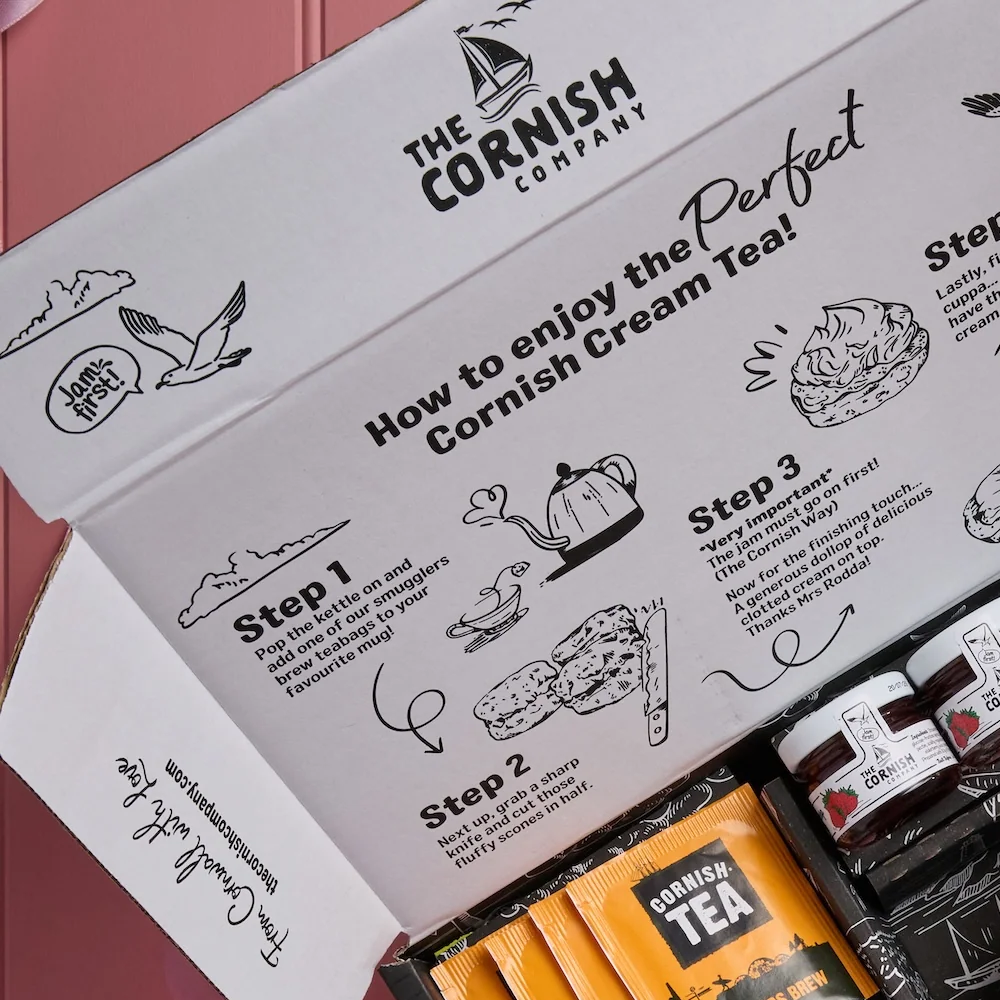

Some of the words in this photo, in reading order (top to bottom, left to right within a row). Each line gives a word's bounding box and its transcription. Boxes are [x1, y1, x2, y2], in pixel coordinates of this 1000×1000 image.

[403, 114, 472, 168] THE
[421, 57, 645, 212] CORNISH
[515, 102, 645, 193] COMPANY
[364, 382, 451, 447] How
[458, 355, 504, 390] to
[511, 281, 616, 359] enjoy
[624, 239, 692, 289] the
[679, 89, 865, 251] Perfect
[936, 266, 986, 300] Lastly,
[943, 281, 998, 314] cuppa...
[426, 354, 581, 455] Cornish
[583, 273, 712, 358] Cream
[712, 213, 797, 277] Tea!
[948, 303, 983, 328] have
[956, 310, 1000, 342] cream
[58, 363, 102, 406] Jam
[72, 368, 125, 421] first!
[688, 476, 773, 534] Step
[777, 454, 801, 480] 3
[706, 550, 734, 568] The
[735, 532, 763, 555] jam
[765, 507, 802, 535] must
[804, 497, 821, 513] go
[823, 484, 841, 498] on
[843, 457, 879, 486] first!
[715, 560, 746, 582] (The
[747, 526, 801, 561] Cornish
[801, 500, 838, 527] Way)
[725, 579, 755, 602] Now
[758, 564, 779, 582] for
[783, 549, 806, 567] the
[808, 510, 870, 551] finishing
[871, 482, 922, 512] touch...
[735, 603, 745, 615] A
[746, 564, 808, 609] generous
[811, 537, 852, 566] dollop
[855, 523, 869, 539] of
[873, 488, 932, 528] delicious
[741, 589, 790, 625] clotted
[793, 564, 835, 594] cream
[837, 552, 855, 566] on
[856, 536, 884, 554] top.
[233, 582, 326, 643] Step
[326, 560, 351, 585] 1
[254, 639, 286, 661] Pop
[287, 622, 314, 640] the
[313, 593, 361, 624] kettle
[363, 579, 382, 595] on
[384, 558, 412, 582] and
[267, 650, 296, 673] add
[297, 634, 324, 654] one
[326, 618, 342, 636] of
[346, 604, 369, 624] our
[373, 556, 449, 607] smugglers
[746, 604, 796, 636] Thanks
[797, 588, 822, 607] Mrs
[823, 555, 871, 591] Rodda!
[274, 658, 313, 686] brew
[315, 621, 376, 660] teabags
[376, 609, 394, 623] to
[395, 586, 428, 614] your
[286, 652, 355, 698] favourite
[357, 625, 394, 654] mug!
[981, 688, 997, 700] THE
[115, 757, 157, 808] Love
[420, 774, 504, 829] Step
[506, 754, 531, 778] 2
[437, 824, 471, 848] Next
[472, 814, 495, 827] up,
[496, 791, 527, 815] grab
[529, 784, 539, 792] a
[541, 758, 579, 785] sharp
[860, 765, 877, 778] THE
[864, 753, 916, 790] CORNISH
[132, 799, 190, 844] with
[165, 758, 278, 895] thecornishcompany.com
[445, 834, 483, 859] knife
[485, 814, 511, 835] and
[512, 800, 536, 818] cut
[537, 777, 575, 802] those
[455, 840, 495, 869] fluffy
[498, 811, 544, 843] scones
[544, 802, 559, 813] in
[559, 781, 593, 804] half.
[174, 835, 255, 926] Cornwall
[650, 861, 729, 914] CORNISH
[664, 880, 754, 946] TEA
[258, 905, 289, 967] From
[788, 969, 828, 998] BREW
